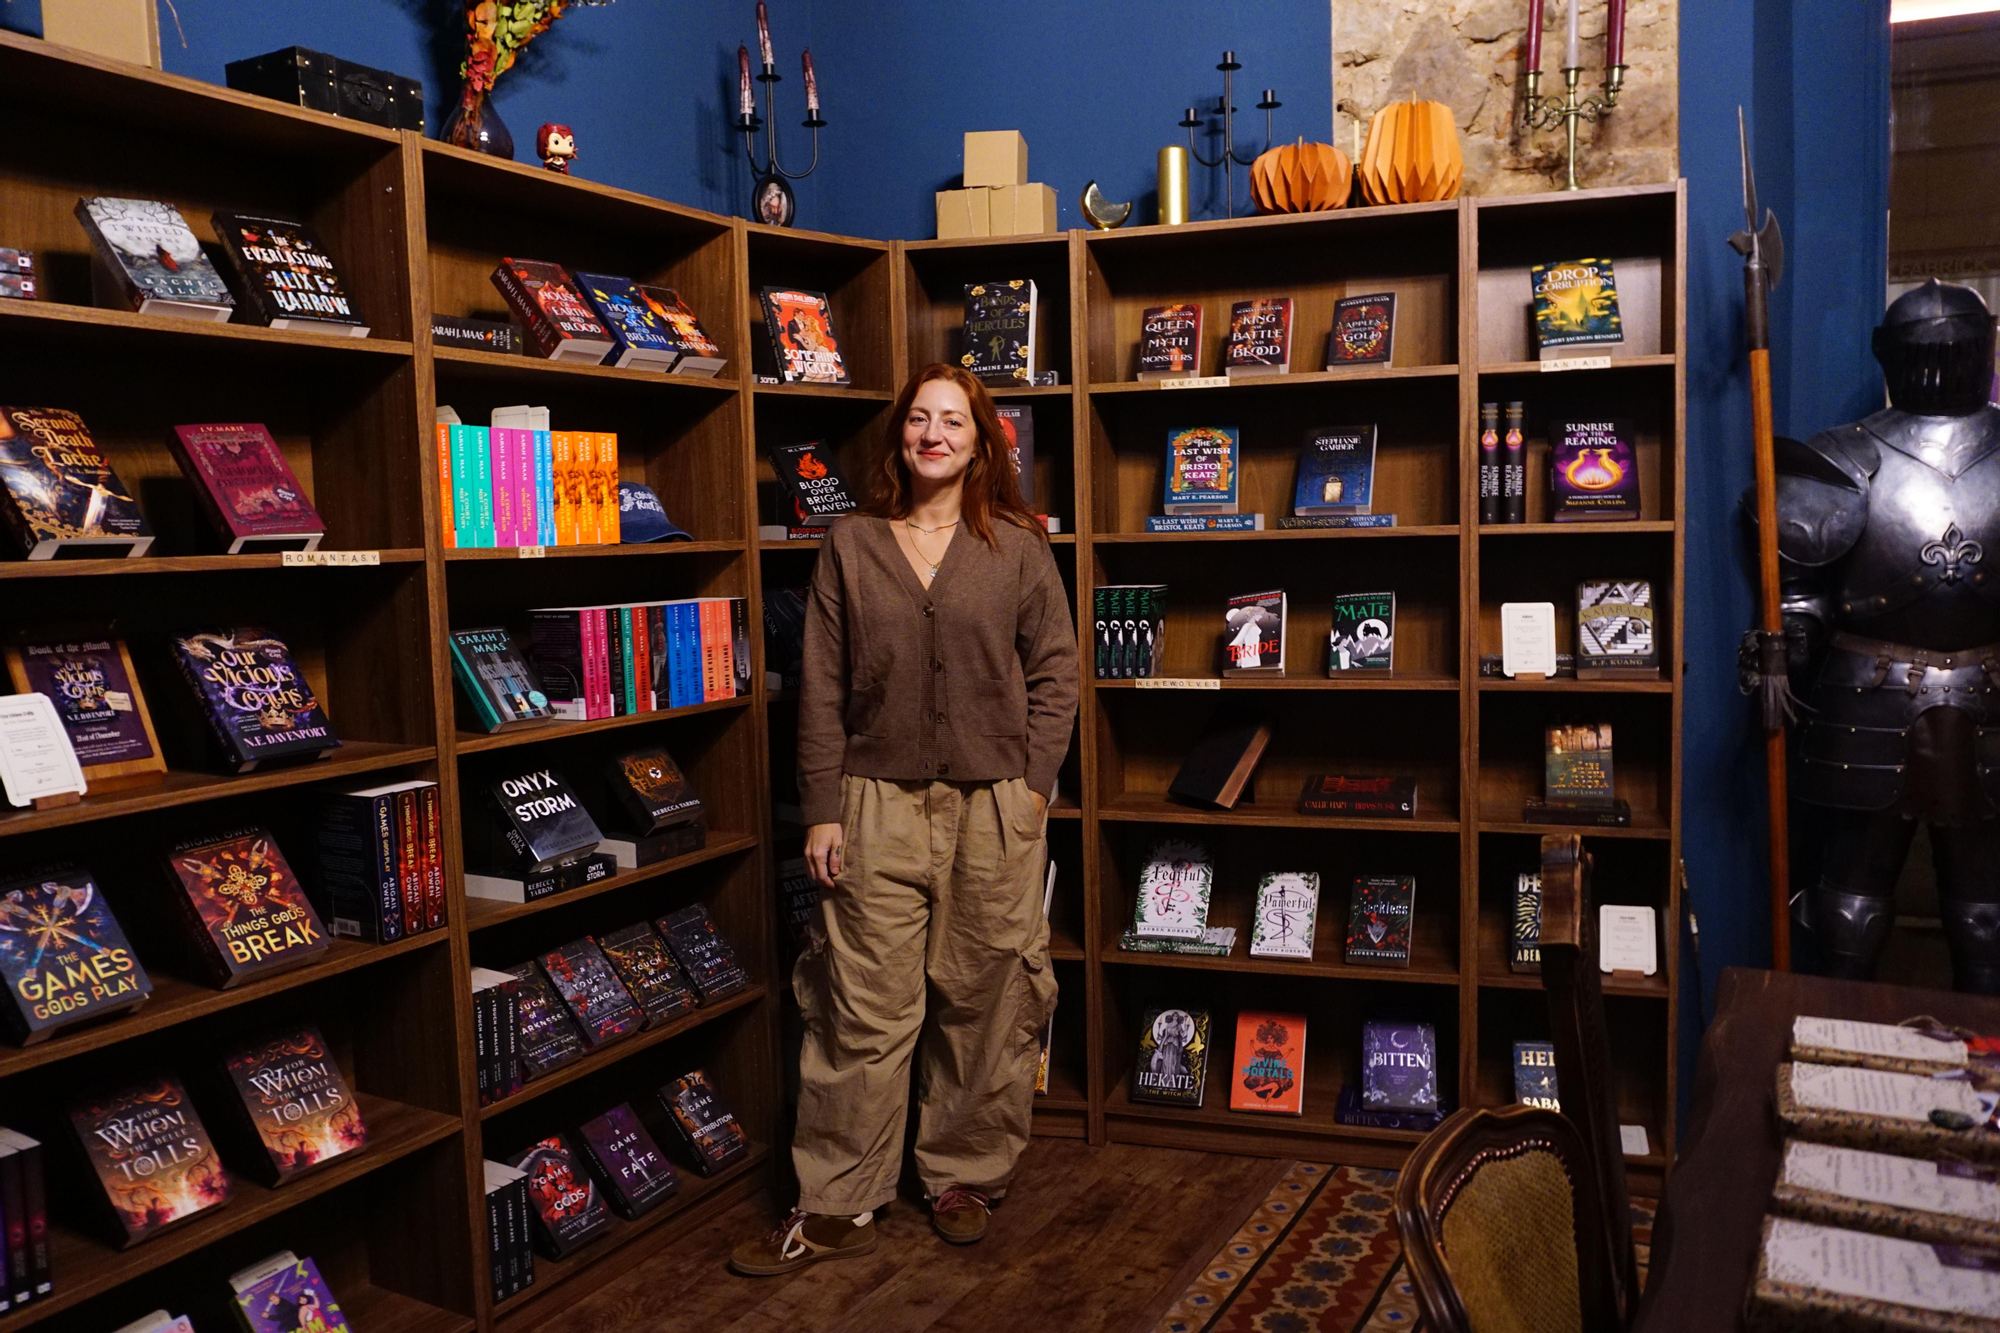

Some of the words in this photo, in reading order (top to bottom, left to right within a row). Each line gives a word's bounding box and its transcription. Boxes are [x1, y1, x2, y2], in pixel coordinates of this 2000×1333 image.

[110, 224, 183, 236] TWISTED
[242, 246, 333, 270] EVERLASTING
[271, 270, 311, 291] ALIX
[1546, 267, 1599, 282] DROP
[144, 277, 217, 289] RACHEL
[1535, 277, 1613, 293] CORRUPTION
[155, 286, 219, 297] GILLIG
[539, 290, 577, 304] HOUSE
[272, 289, 351, 316] HARROW
[606, 302, 645, 315] HOUSE
[980, 295, 1016, 308] BONDS
[552, 306, 589, 318] EARTH
[661, 312, 695, 323] HOUSE
[989, 308, 1003, 318] OF
[1242, 312, 1276, 326] KING
[560, 321, 602, 334] BLOOD
[624, 318, 645, 328] SKY
[969, 318, 1026, 332] HERCULES
[1144, 319, 1195, 333] QUEEN
[1344, 318, 1381, 328] APPLES
[625, 330, 667, 344] BREATH
[1148, 336, 1189, 349] MYTH
[1232, 328, 1284, 343] BATTLE
[1341, 331, 1383, 343] GOLD
[676, 340, 719, 352] SHADOW
[1232, 344, 1282, 358] BLOOD
[784, 348, 842, 363] SOMETHING
[1141, 354, 1193, 364] MONSTERS
[792, 359, 838, 375] WICKED
[970, 364, 999, 372] JASMINE
[1000, 364, 1019, 372] MAS
[1543, 358, 1608, 370] FANTASY
[1161, 378, 1229, 388] VAMPIRES
[12, 412, 80, 432] Second
[1565, 422, 1615, 433] SUNRISE
[34, 427, 94, 450] Death
[1194, 438, 1212, 448] THE
[1315, 436, 1361, 446] STEPHANIE
[1564, 436, 1618, 447] REAPING
[1173, 448, 1198, 456] LAST
[1201, 447, 1232, 456] WISH
[1319, 442, 1356, 452] GARBER
[32, 445, 101, 468] Locke
[1195, 454, 1208, 464] OF
[1180, 462, 1224, 472] BRISTOL
[1184, 470, 1218, 480] KEATS
[1480, 465, 1488, 498] REAPING
[1491, 466, 1500, 498] SUNRISE
[799, 477, 840, 491] BLOOD
[810, 486, 836, 496] OVER
[806, 492, 848, 506] BRIGHT
[812, 502, 851, 515] HAVEN
[1154, 523, 1184, 531] BRISTOL
[284, 553, 378, 564] ROMANTASY
[521, 548, 545, 557] FAE
[1242, 593, 1282, 605] HAZELWOOD
[1350, 595, 1392, 603] HAZELWOOD
[1334, 602, 1391, 622] MATE
[1581, 604, 1650, 620] KATABASIS
[458, 633, 498, 646] SARAH
[473, 642, 508, 655] MAAS
[1226, 639, 1280, 662] BRIDE
[220, 650, 256, 667] Our
[1610, 658, 1644, 666] KUANG
[54, 668, 104, 686] Vicious
[203, 661, 295, 688] Vicious
[71, 684, 106, 699] Oaths
[241, 688, 304, 710] Oaths
[243, 736, 266, 748] N.E.
[266, 726, 328, 745] DAVENPORT
[500, 769, 559, 800] ONYX
[514, 792, 578, 823] STORM
[652, 804, 678, 818] REBECCA
[679, 799, 701, 811] YARROS
[174, 834, 222, 852] ABIGAIL
[222, 824, 260, 842] OWEN
[505, 831, 524, 857] STORM
[511, 828, 527, 850] ONYX
[379, 806, 388, 840] GAMES
[387, 876, 396, 911] ABIGAIL
[586, 868, 607, 882] STORM
[587, 862, 605, 876] ONYX
[432, 865, 442, 898] ABIGAIL
[527, 878, 556, 892] REBECCA
[382, 881, 391, 909] OWEN
[529, 886, 555, 898] YARROS
[249, 906, 266, 918] THE
[220, 914, 269, 942] THINGS
[270, 906, 306, 929] GODS
[1167, 927, 1198, 935] ROBERTS
[226, 918, 321, 966] BREAK
[688, 940, 718, 956] TOUCH
[57, 950, 81, 965] THE
[1377, 951, 1407, 959] ROBERTS
[630, 956, 663, 974] TOUCH
[17, 947, 134, 1002] GAMES
[642, 972, 673, 990] MALICE
[32, 991, 88, 1020] GODS
[95, 976, 139, 1002] PLAY
[586, 989, 616, 1008] CHAOS
[284, 1058, 306, 1072] FOR
[1249, 1057, 1289, 1070] DIVINE
[1372, 1052, 1427, 1070] BITTEN
[1242, 1066, 1294, 1080] MORTALS
[248, 1062, 330, 1101] WHOM
[1138, 1072, 1195, 1092] HEKATE
[278, 1089, 298, 1102] THE
[302, 1078, 330, 1094] BELLE
[266, 1086, 344, 1128] TOLLS
[688, 1094, 714, 1114] GAME
[136, 1108, 160, 1121] FOR
[1344, 1114, 1382, 1128] BITTEN
[95, 1110, 186, 1153] WHOM
[692, 1112, 734, 1141] RETRIBUTION
[128, 1141, 151, 1155] THE
[154, 1128, 188, 1146] BELLE
[609, 1132, 638, 1153] GAME
[114, 1136, 202, 1182] TOLLS
[620, 1151, 658, 1180] FATE
[538, 1164, 570, 1186] GAME
[552, 1188, 587, 1212] GODS
